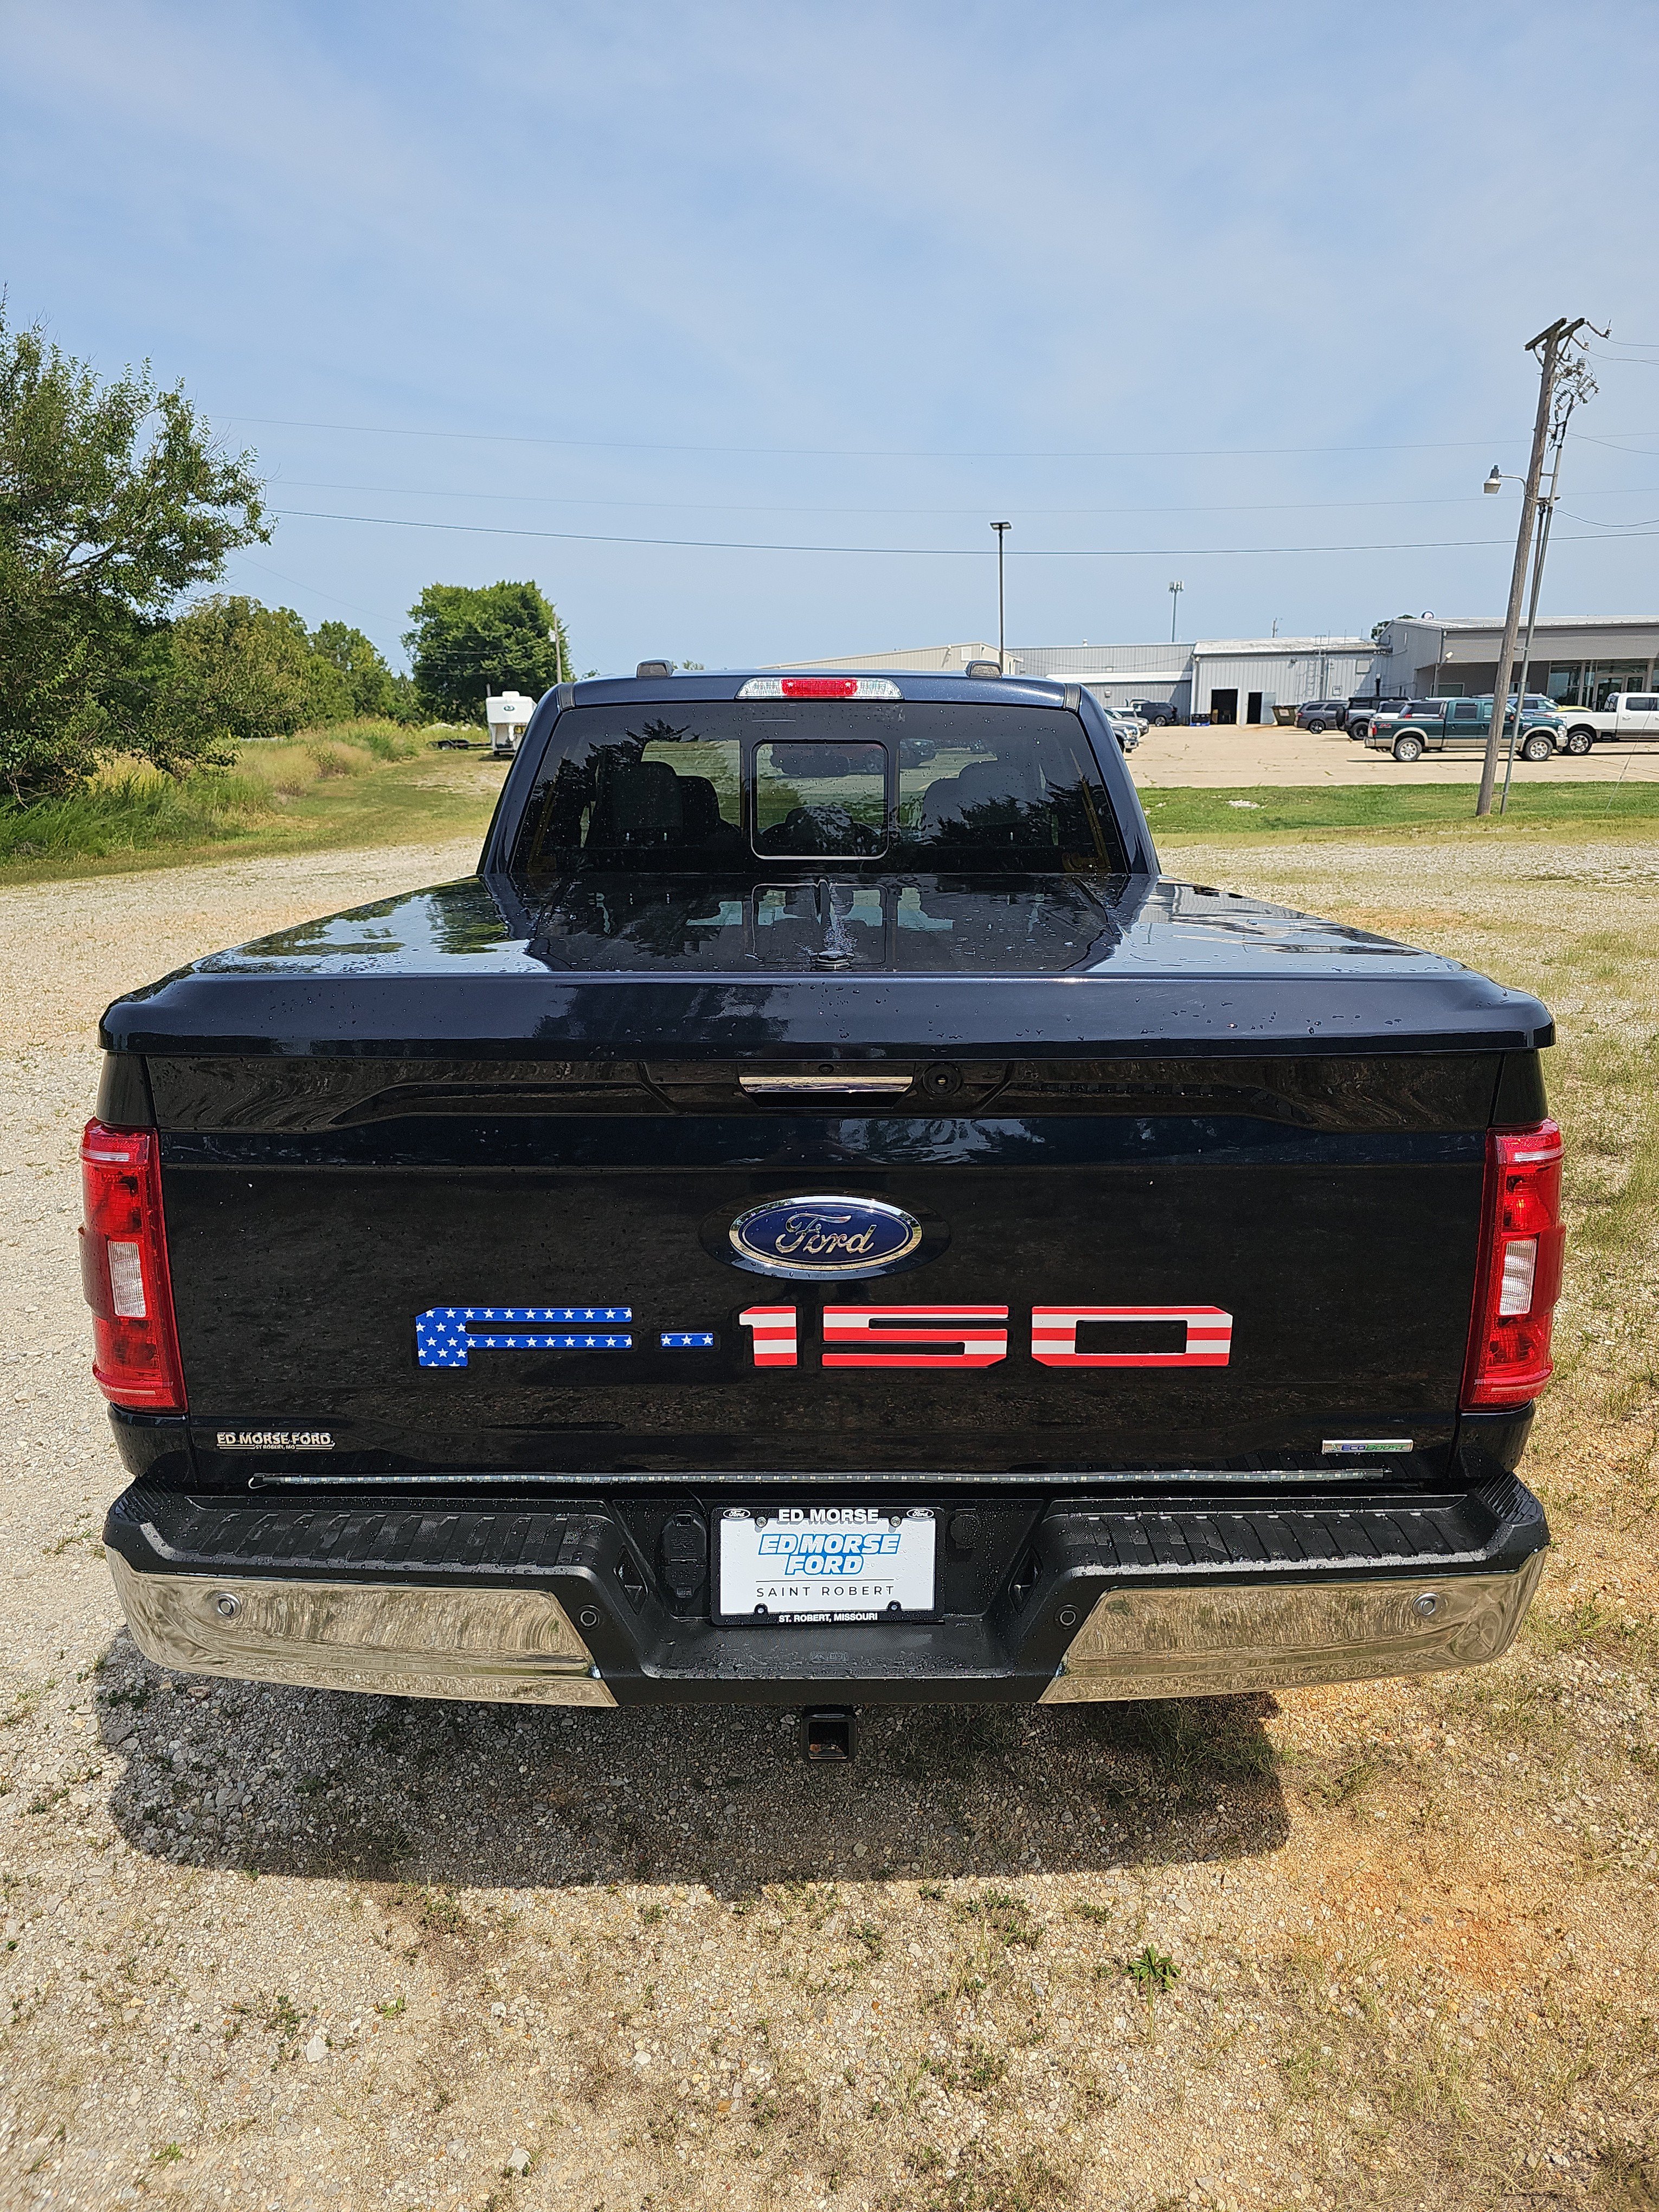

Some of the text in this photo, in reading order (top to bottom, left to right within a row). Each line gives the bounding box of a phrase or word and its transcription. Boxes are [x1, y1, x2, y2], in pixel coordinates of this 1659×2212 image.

[775, 1213, 877, 1254] Ford
[415, 1306, 1233, 1368] F-150
[217, 1432, 332, 1444] ED MORSE FORD
[779, 1509, 879, 1522] ED MORSE
[758, 1534, 902, 1555] ED MORSE
[785, 1555, 864, 1575] FORD
[757, 1585, 895, 1597] SAINT ROBERT
[794, 1614, 832, 1622] ROBERT,
